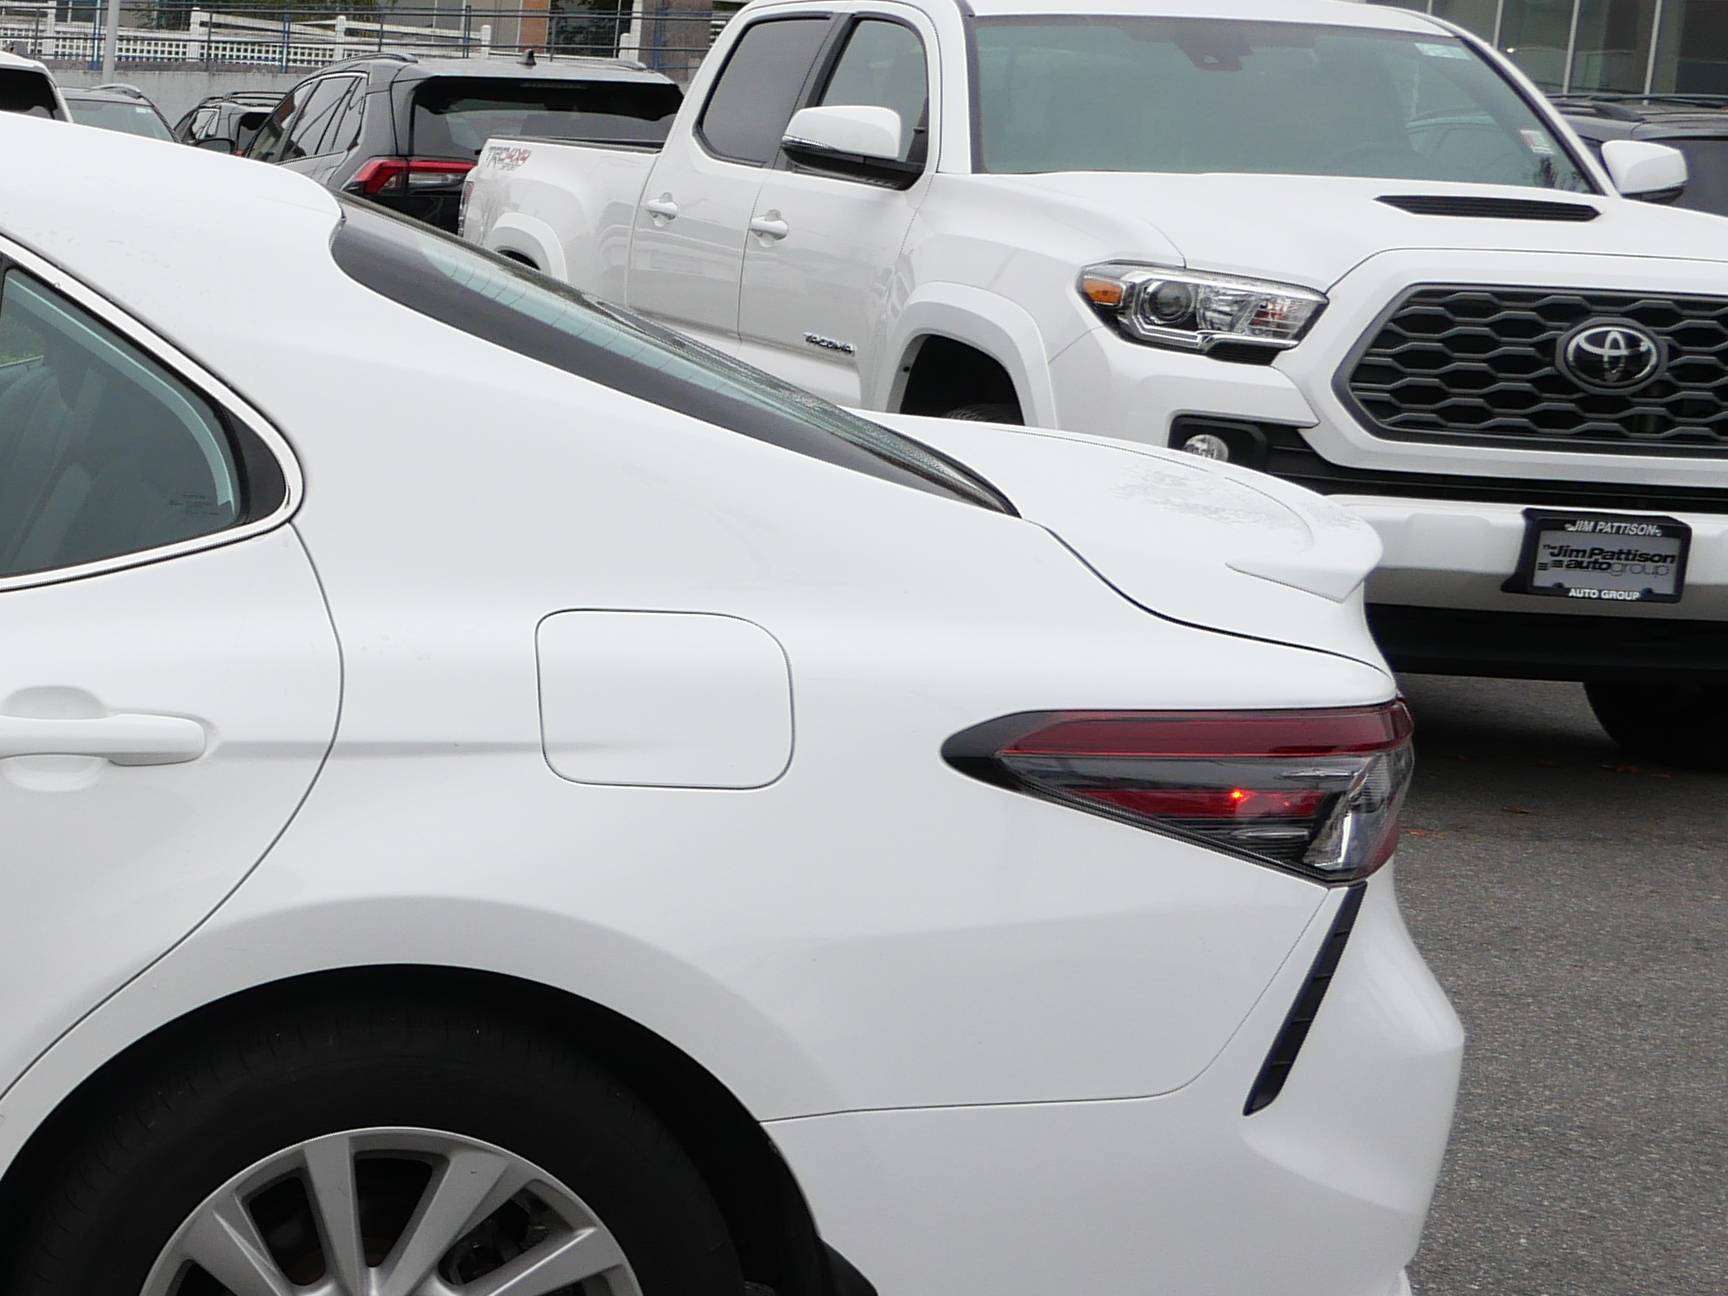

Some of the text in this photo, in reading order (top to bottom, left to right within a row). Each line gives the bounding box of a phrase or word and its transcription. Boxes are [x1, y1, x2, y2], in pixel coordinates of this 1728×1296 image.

[1574, 520, 1656, 536] JIM PATTISON
[1569, 588, 1640, 601] AUTO GROUP
